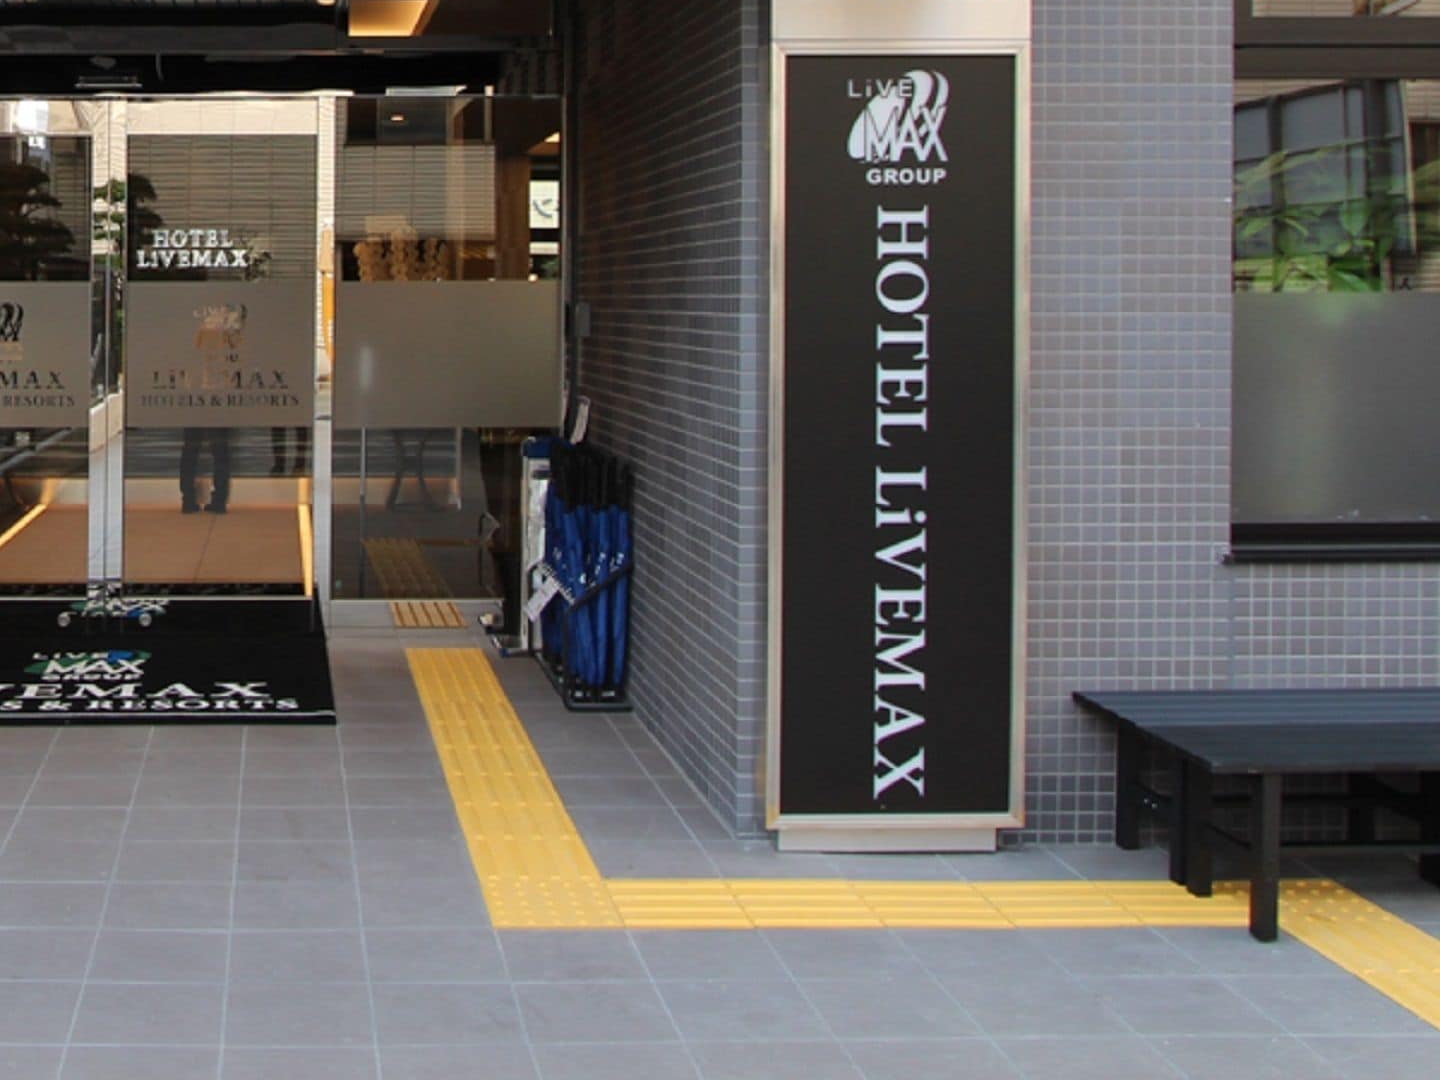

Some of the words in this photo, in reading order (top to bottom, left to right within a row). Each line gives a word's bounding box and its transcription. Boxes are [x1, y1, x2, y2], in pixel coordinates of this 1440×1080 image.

[848, 79, 913, 98] LiVE
[863, 104, 949, 162] MAX
[866, 167, 947, 185] GROUP
[151, 228, 234, 248] HOTEL
[875, 204, 930, 448] HOTEL
[0, 395, 76, 408] RESORTS
[872, 466, 927, 801] LiVEMAX
[42, 659, 146, 675] MAX
[37, 700, 73, 711] &
[84, 699, 300, 711] RESORTS
